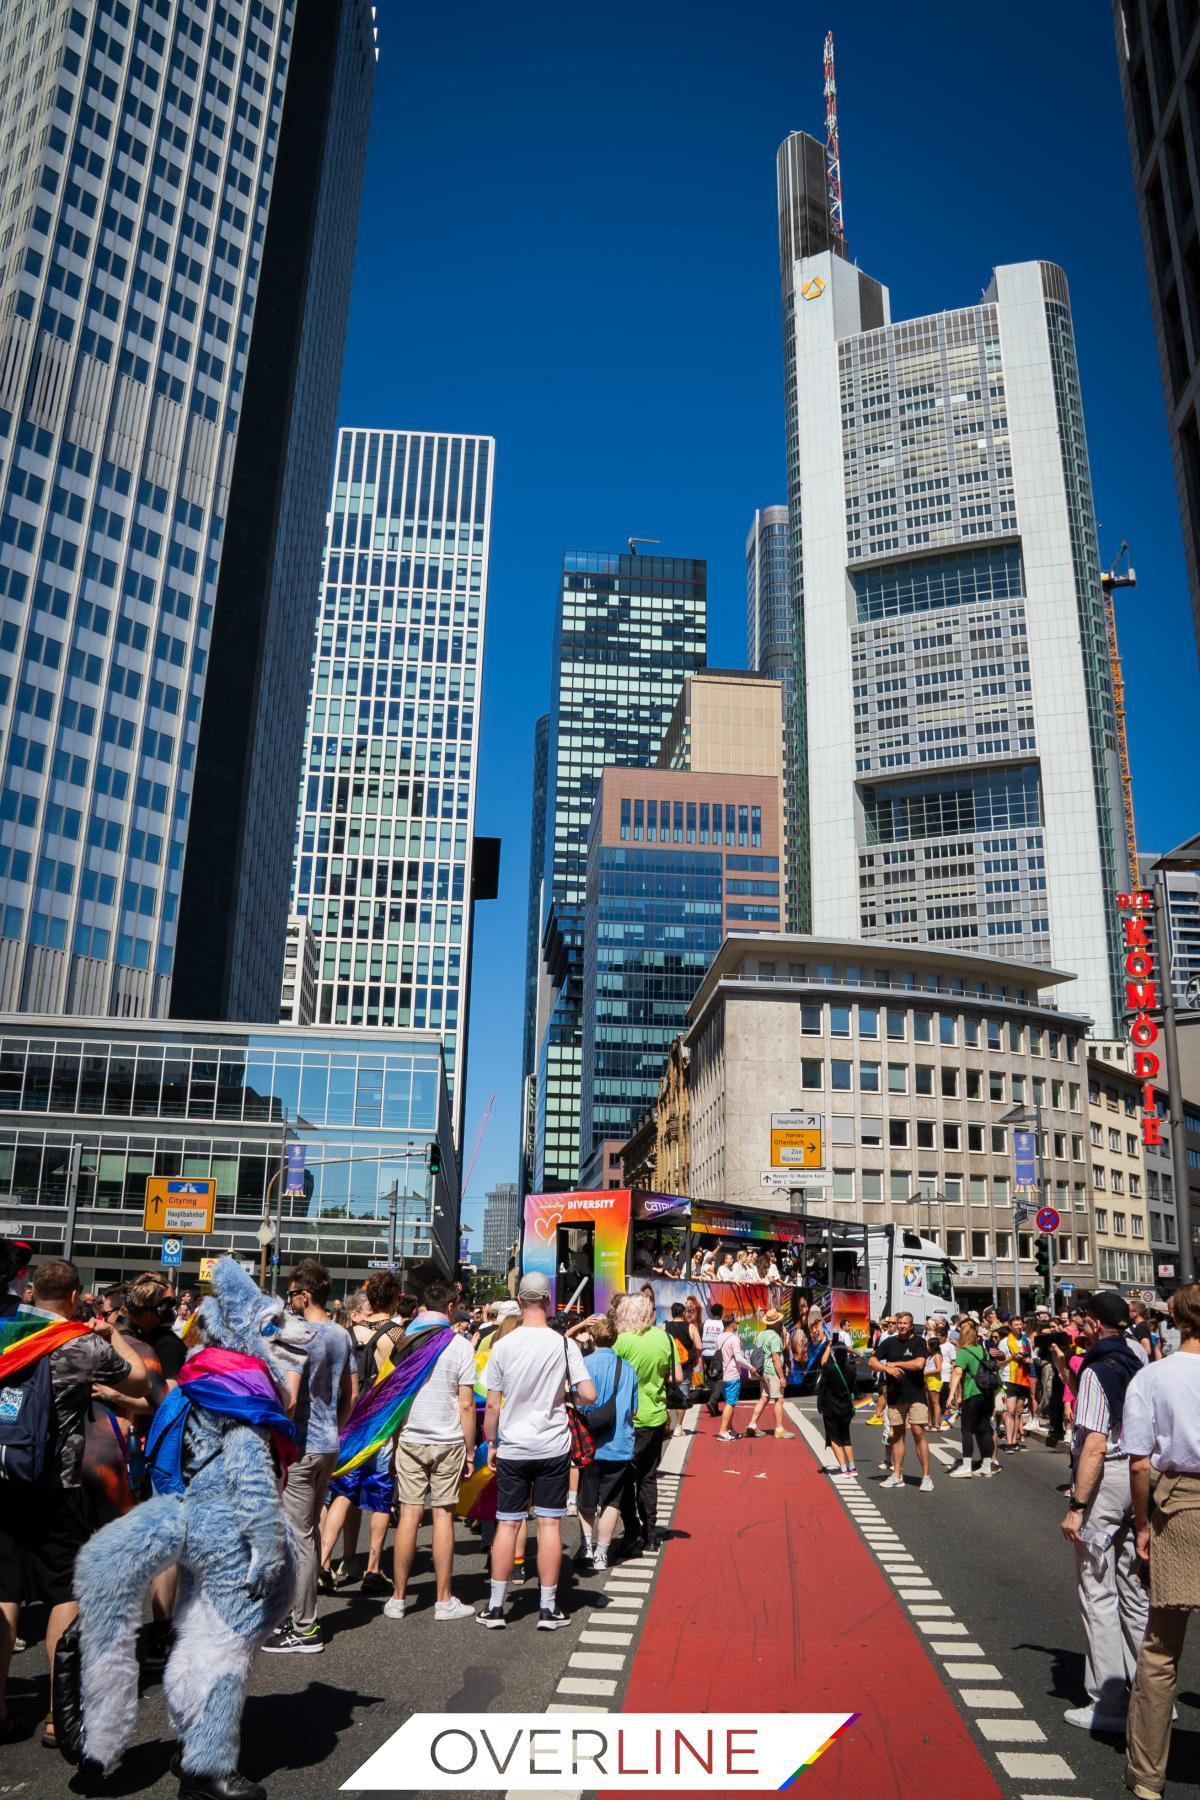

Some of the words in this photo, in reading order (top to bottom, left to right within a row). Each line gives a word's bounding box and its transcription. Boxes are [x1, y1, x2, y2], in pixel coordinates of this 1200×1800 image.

[1117, 893, 1151, 908] DIE
[1125, 919, 1163, 1145] KOMÖDIE
[168, 1197, 197, 1206] Cityring
[567, 1199, 615, 1210] DIVERSITY
[167, 1210, 205, 1219] Hauptbahnhof
[180, 1220, 193, 1228] Oper
[711, 1216, 752, 1232] DIVERSITY
[201, 1271, 212, 1279] TA
